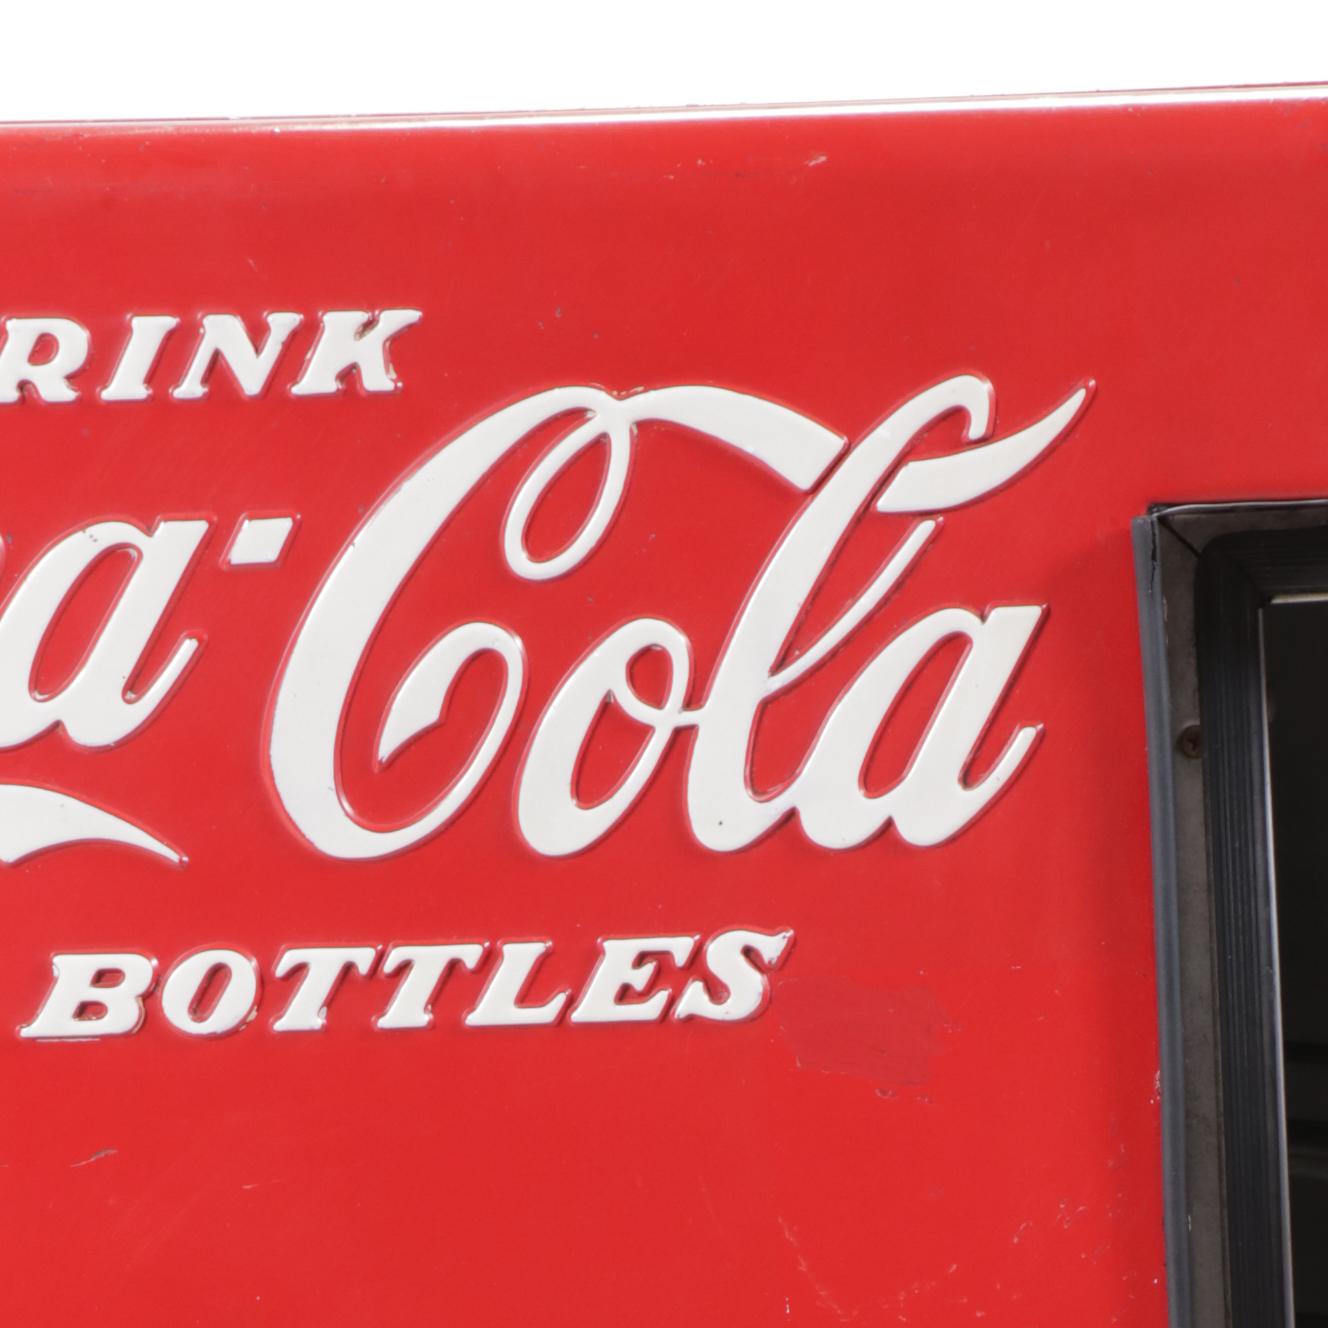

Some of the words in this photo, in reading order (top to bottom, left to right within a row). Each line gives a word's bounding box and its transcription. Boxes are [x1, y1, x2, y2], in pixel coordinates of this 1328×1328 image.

[0, 309, 422, 403] RINK
[0, 370, 1096, 860] a-Cola
[18, 930, 794, 1039] BOTTLES
